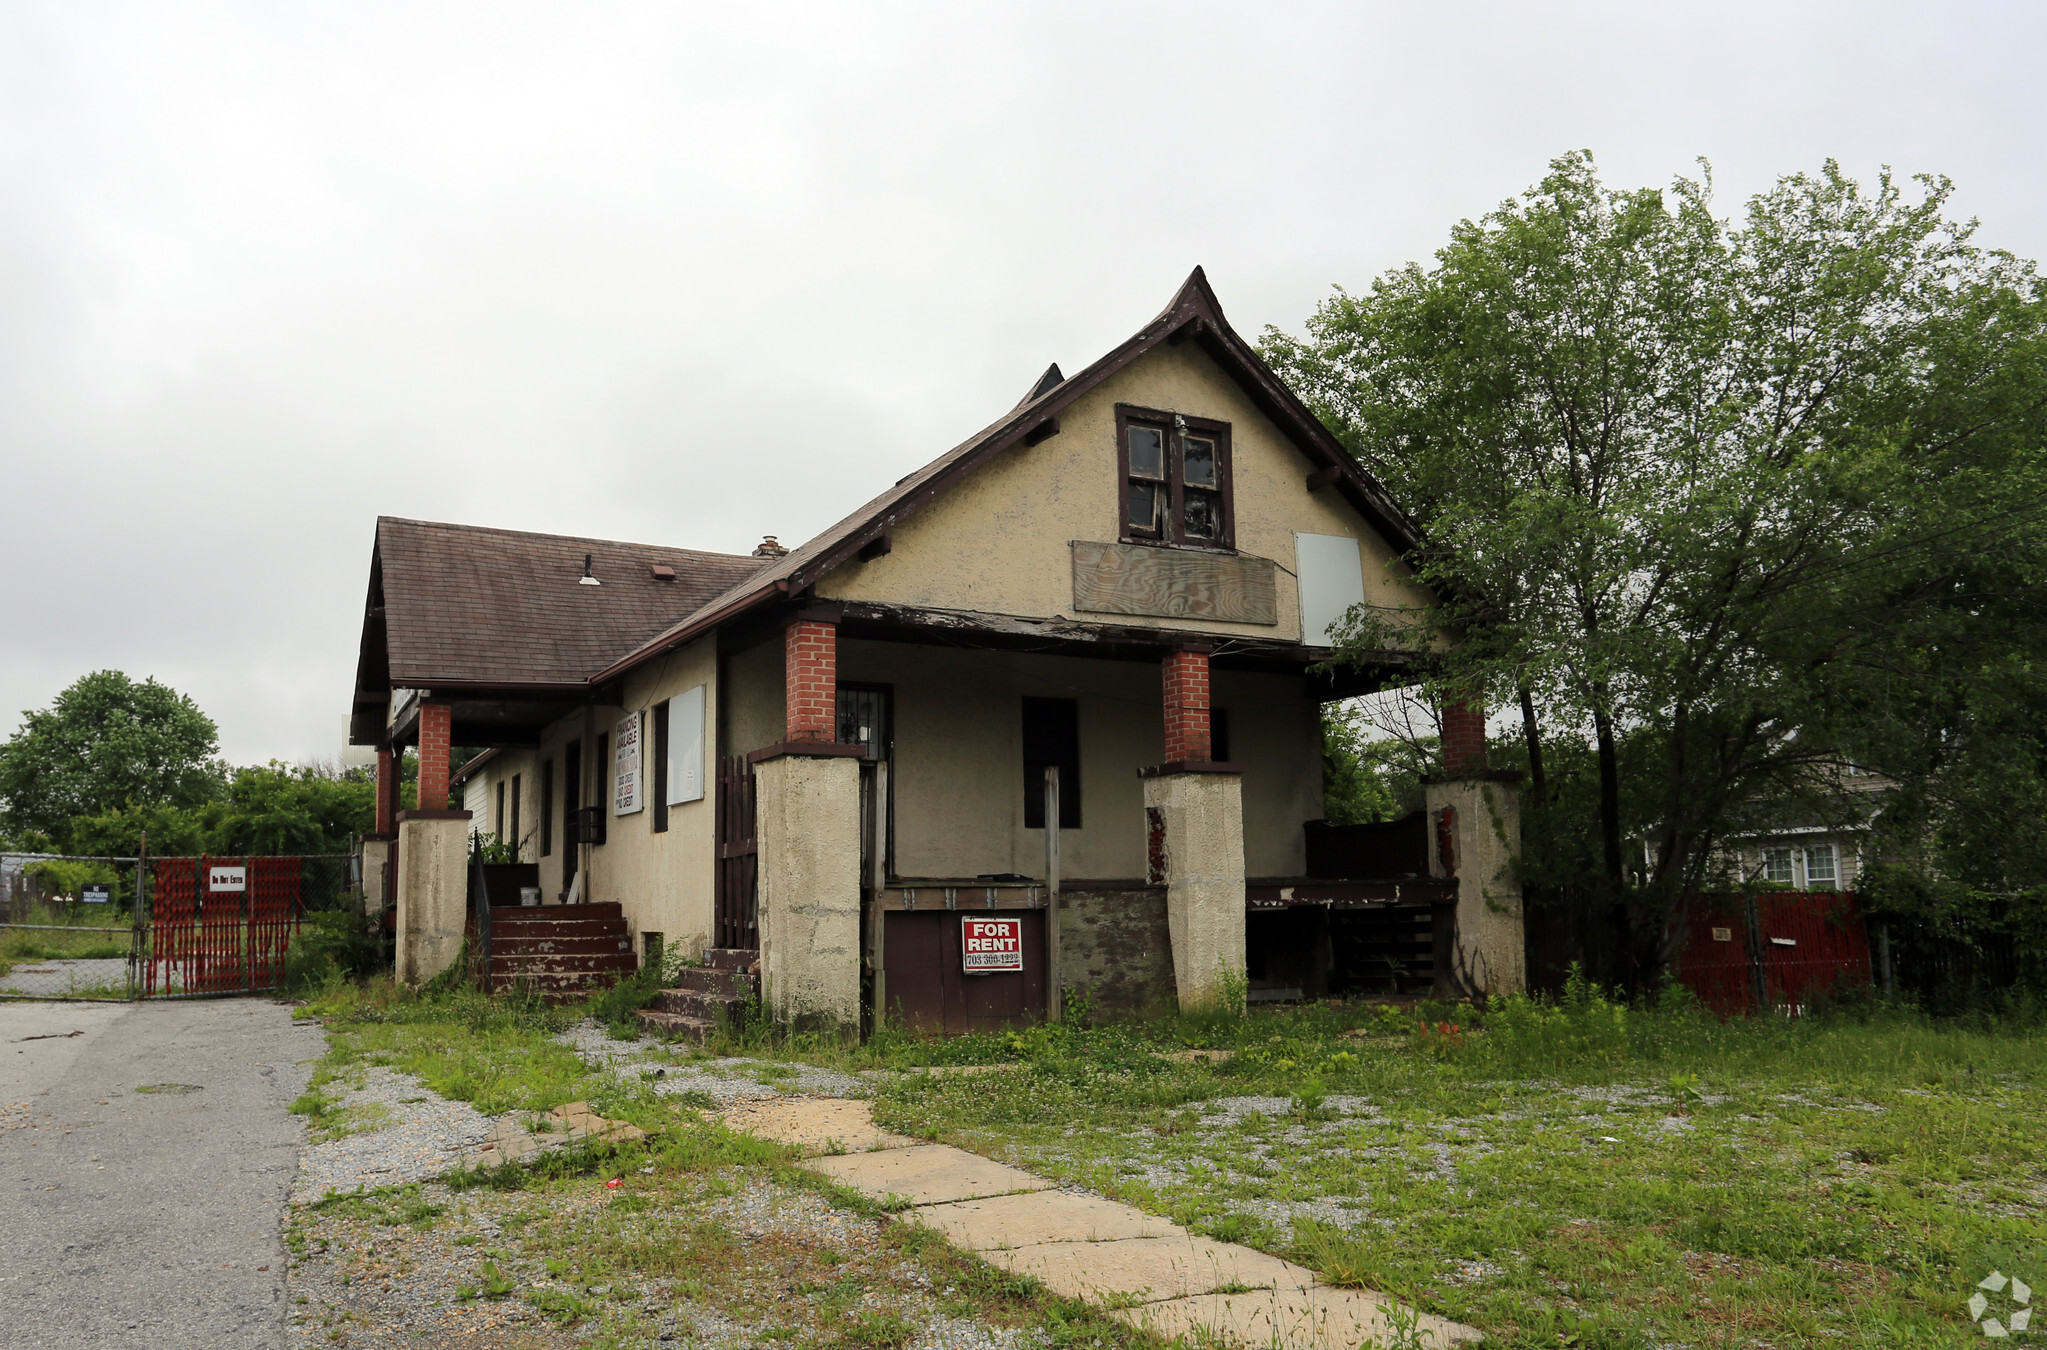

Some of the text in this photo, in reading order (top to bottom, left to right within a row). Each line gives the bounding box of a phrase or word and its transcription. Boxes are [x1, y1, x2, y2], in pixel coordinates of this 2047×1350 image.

[617, 715, 637, 737] FINANCING
[617, 730, 637, 749] AVAILABLE
[974, 924, 1009, 936] FOR
[968, 939, 1016, 950] RENT
[967, 954, 982, 965] 703
